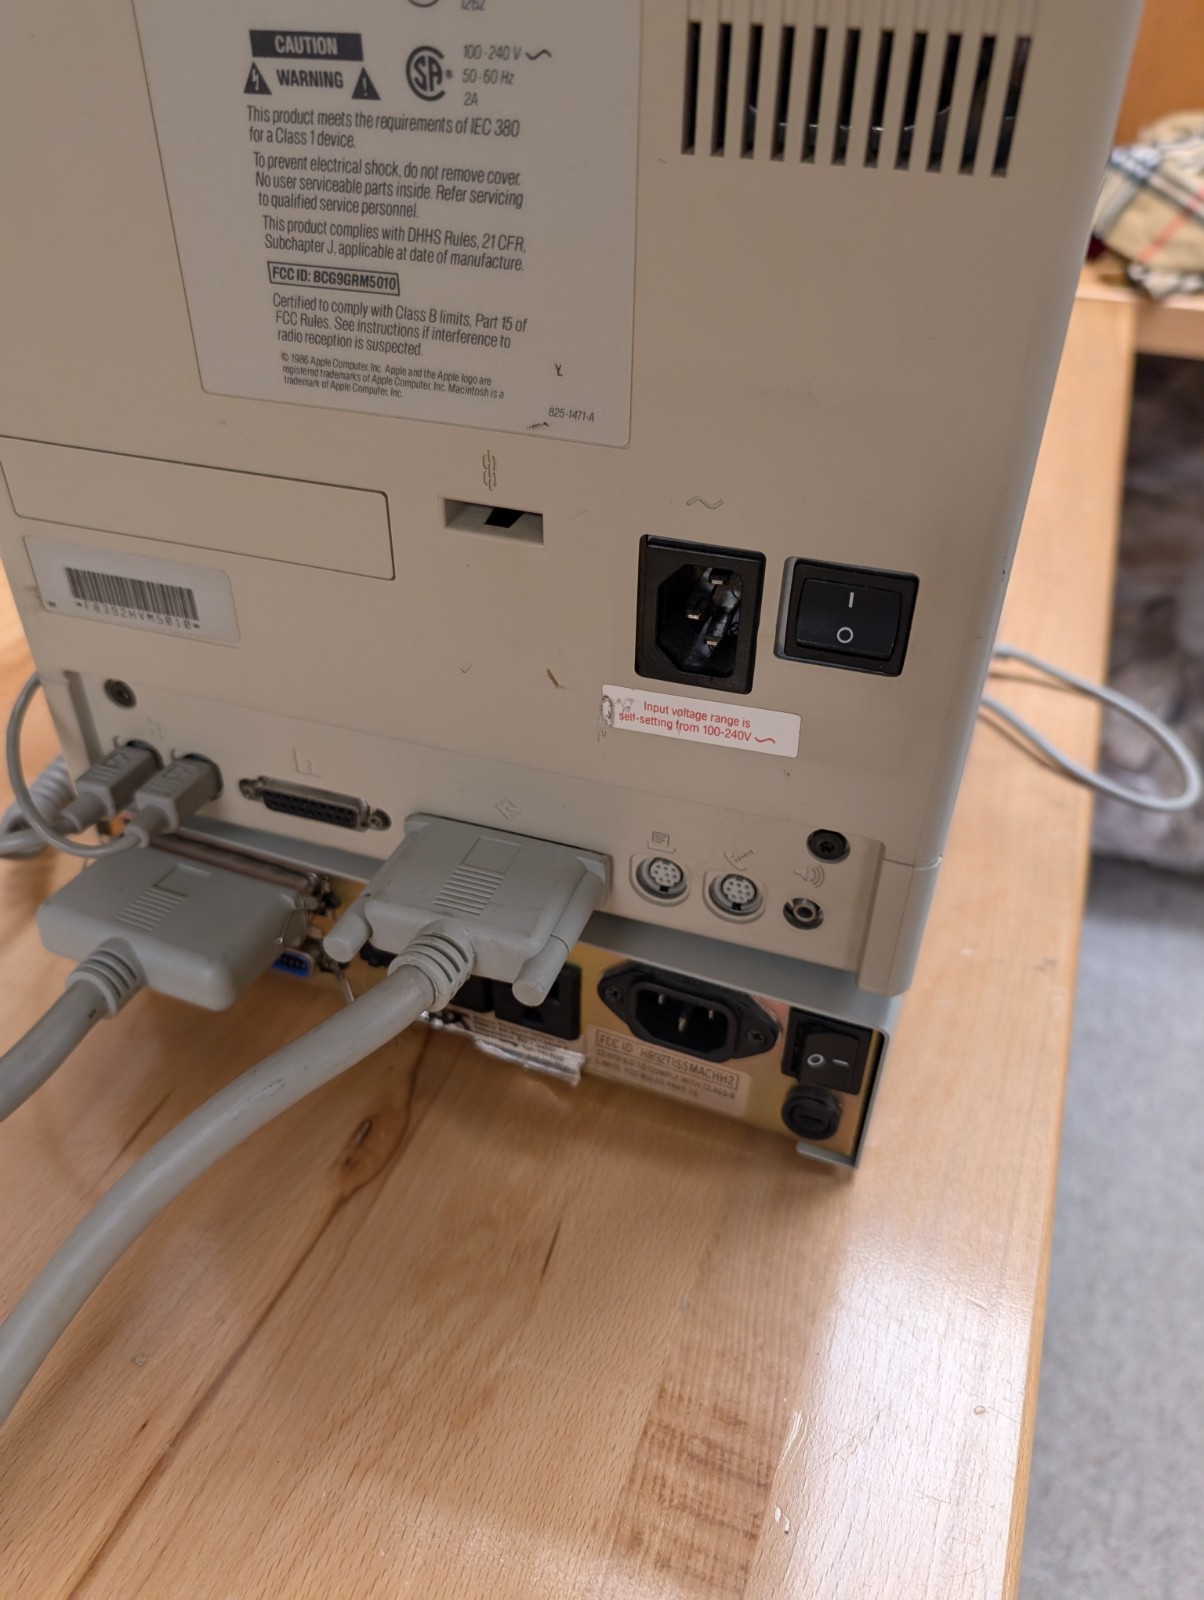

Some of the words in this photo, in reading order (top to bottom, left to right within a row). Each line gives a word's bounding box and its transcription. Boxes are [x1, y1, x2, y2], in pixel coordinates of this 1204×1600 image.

[274, 35, 338, 56] CAUTION
[276, 69, 344, 89] WARNING
[500, 70, 515, 85] Hz
[463, 91, 478, 106] 2A
[247, 105, 270, 123] This
[273, 108, 314, 126] product
[318, 112, 352, 127] meets
[355, 111, 374, 129] the
[375, 114, 452, 134] requirements
[455, 117, 469, 134] of
[470, 117, 492, 136] IEC
[494, 118, 520, 138] 380
[249, 126, 264, 143] for
[266, 129, 273, 143] a
[275, 127, 307, 145] Class
[310, 130, 315, 145] 1
[317, 130, 356, 148] device.
[253, 151, 265, 168] To
[267, 155, 307, 171] prevent
[310, 156, 362, 175] electrical
[365, 160, 401, 178] shock,
[404, 162, 418, 179] do
[421, 165, 438, 180] not
[441, 167, 484, 184] remove
[487, 170, 521, 186] cover.
[256, 171, 271, 187] No
[273, 175, 297, 189] user
[300, 176, 362, 194] serviceable
[365, 181, 393, 197] parts
[396, 181, 432, 200] inside.
[436, 184, 468, 202] Refer
[470, 188, 524, 210] servicing
[259, 192, 269, 206] to
[271, 192, 318, 210] qualified
[320, 198, 360, 213] service
[362, 201, 419, 218] personnel.
[262, 215, 285, 232] This
[287, 219, 327, 235] product
[330, 223, 379, 240] complies
[382, 226, 405, 242] with
[408, 226, 442, 245] DHHS
[482, 233, 496, 250] 21
[265, 234, 325, 254] Subchapter
[338, 242, 394, 260] applicable
[396, 246, 407, 260] at
[409, 247, 434, 263] date
[436, 249, 448, 264] of
[450, 252, 524, 272] manufacture.
[272, 266, 294, 280] FCC
[296, 269, 310, 282] ID:
[313, 270, 396, 290] BCG9GRM5010
[273, 292, 317, 311] Certified
[319, 298, 329, 312] to
[331, 301, 369, 319] comply
[371, 303, 393, 319] with
[396, 305, 426, 322] Class
[429, 308, 437, 323] B
[475, 313, 498, 329] Part
[502, 316, 513, 331] 15
[515, 318, 528, 333] of
[276, 310, 297, 326] FCC
[300, 313, 331, 330] Rules.
[335, 316, 355, 332] See
[357, 319, 420, 338] instructions
[422, 325, 430, 340] if
[432, 326, 497, 348] interference
[500, 335, 511, 349] to
[278, 329, 302, 343] radio
[305, 333, 352, 349] reception
[354, 336, 363, 350] is
[366, 339, 423, 356] suspected.
[282, 365, 319, 377] registered
[320, 370, 360, 382] trademarks
[362, 374, 370, 383] of
[372, 374, 393, 385] Apple
[448, 383, 489, 398] Macintosh
[490, 389, 498, 399] is
[499, 391, 504, 399] a
[284, 376, 320, 388] trademark
[322, 380, 329, 389] of
[330, 380, 351, 392] Apple
[310, 356, 332, 368] Apple
[385, 364, 406, 376] Apple
[408, 368, 422, 378] and
[424, 369, 436, 380] the
[437, 370, 459, 382] Apple
[461, 374, 478, 385] logo
[479, 377, 492, 386] are
[548, 406, 595, 422] 825-1471-A
[619, 711, 673, 731] self-setting
[676, 720, 700, 733] from
[703, 725, 752, 741] 100-240V
[644, 701, 669, 715] Input
[672, 706, 708, 722] voltage
[710, 714, 740, 728] range
[742, 717, 751, 728] is
